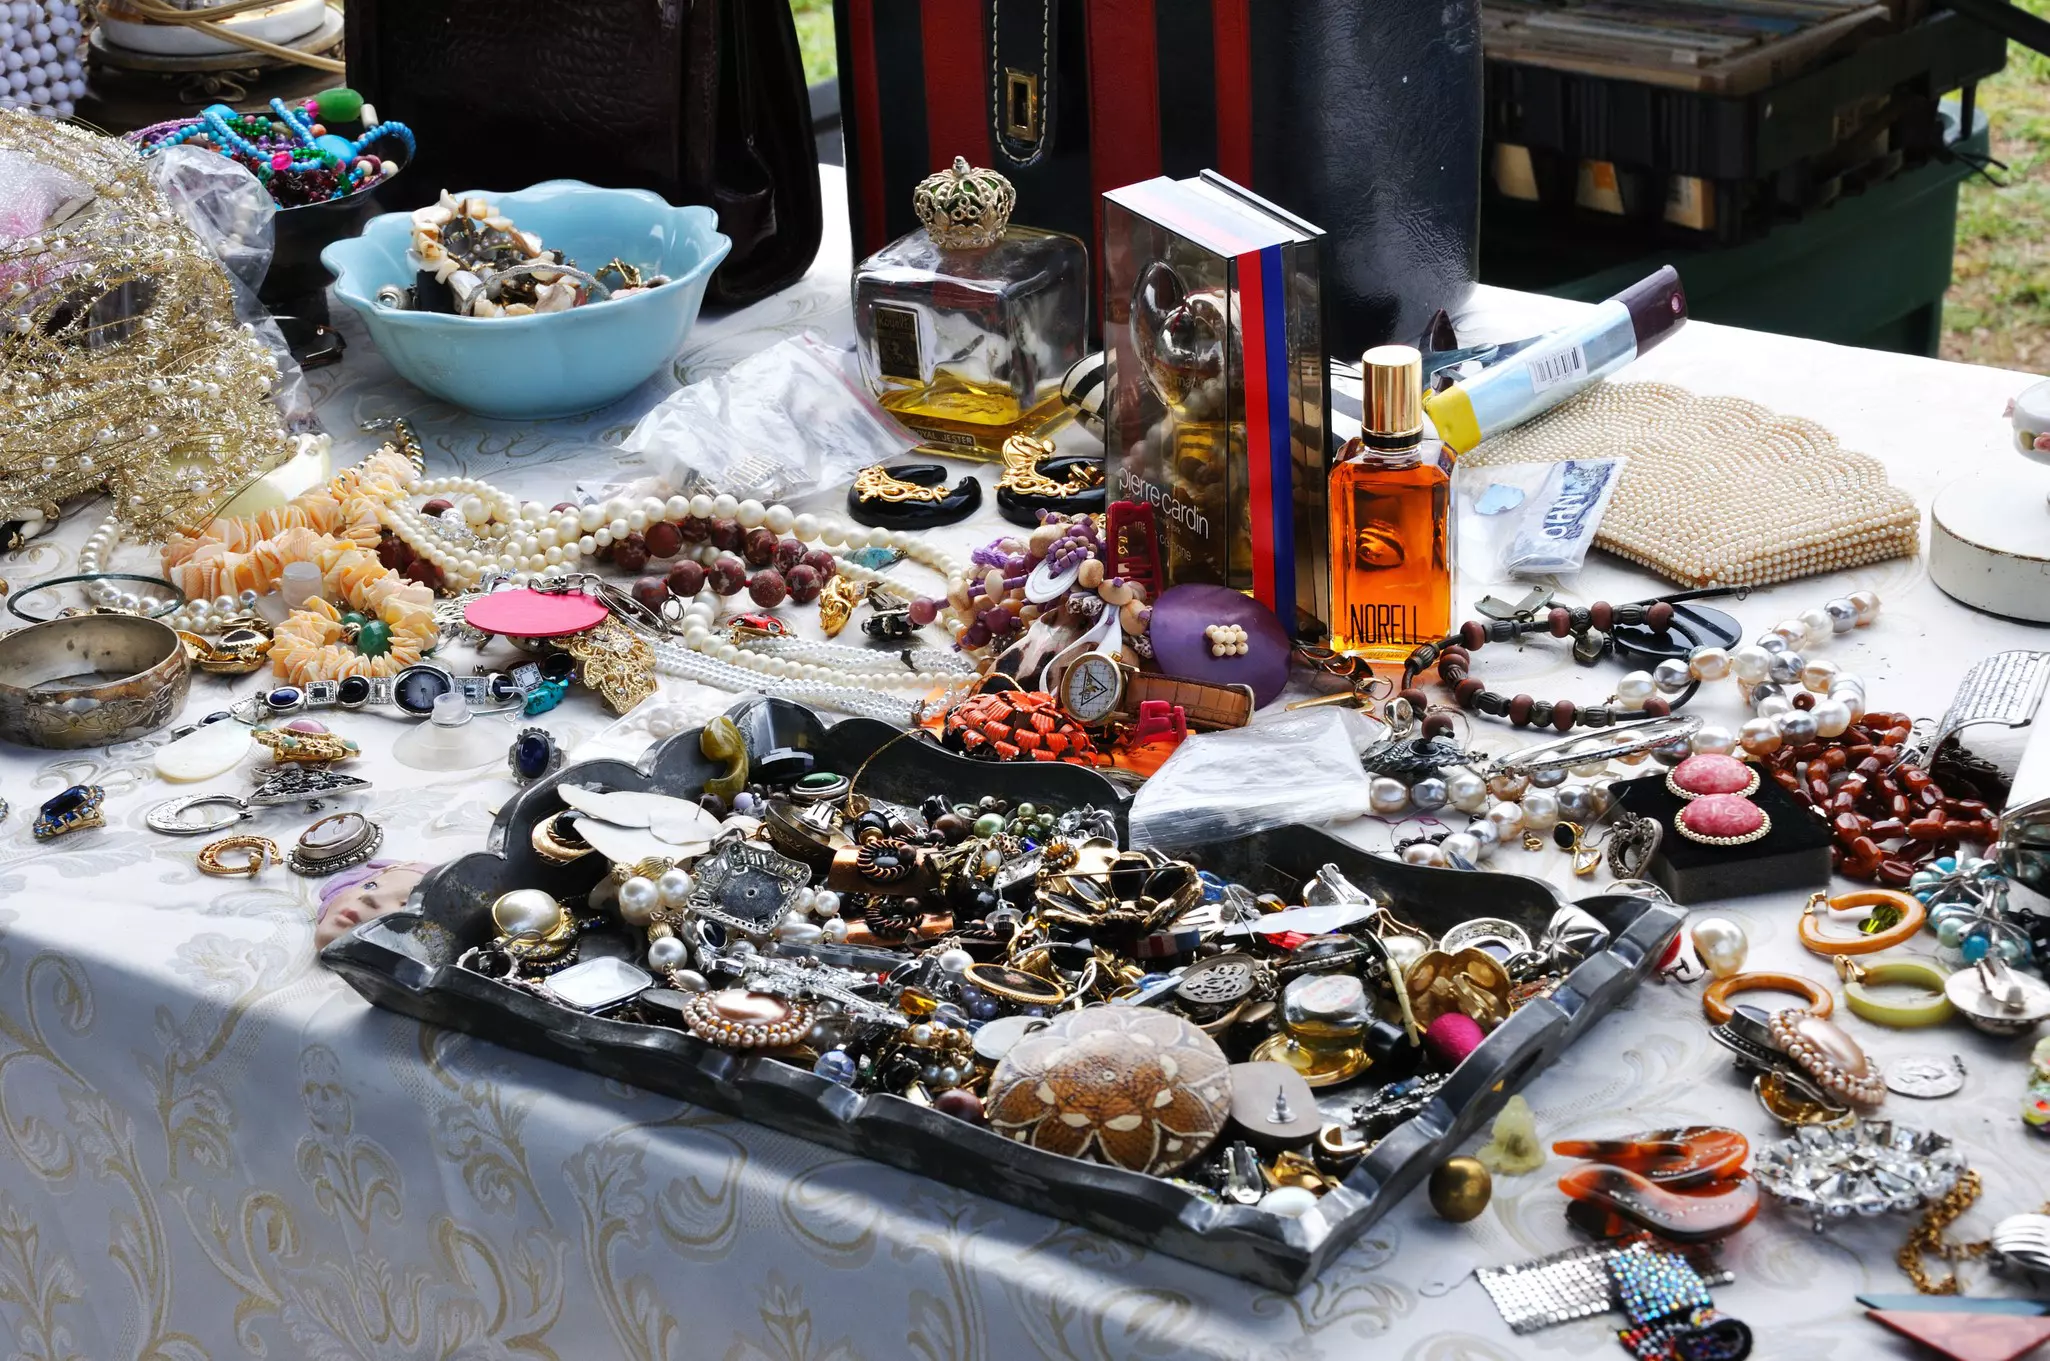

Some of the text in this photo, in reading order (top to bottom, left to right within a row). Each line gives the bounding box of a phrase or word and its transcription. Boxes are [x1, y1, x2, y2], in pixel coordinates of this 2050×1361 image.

[942, 433, 973, 445] JESTER
[1119, 465, 1161, 508] pierre
[1161, 492, 1210, 540] cardin
[1351, 603, 1425, 645] NORELL
